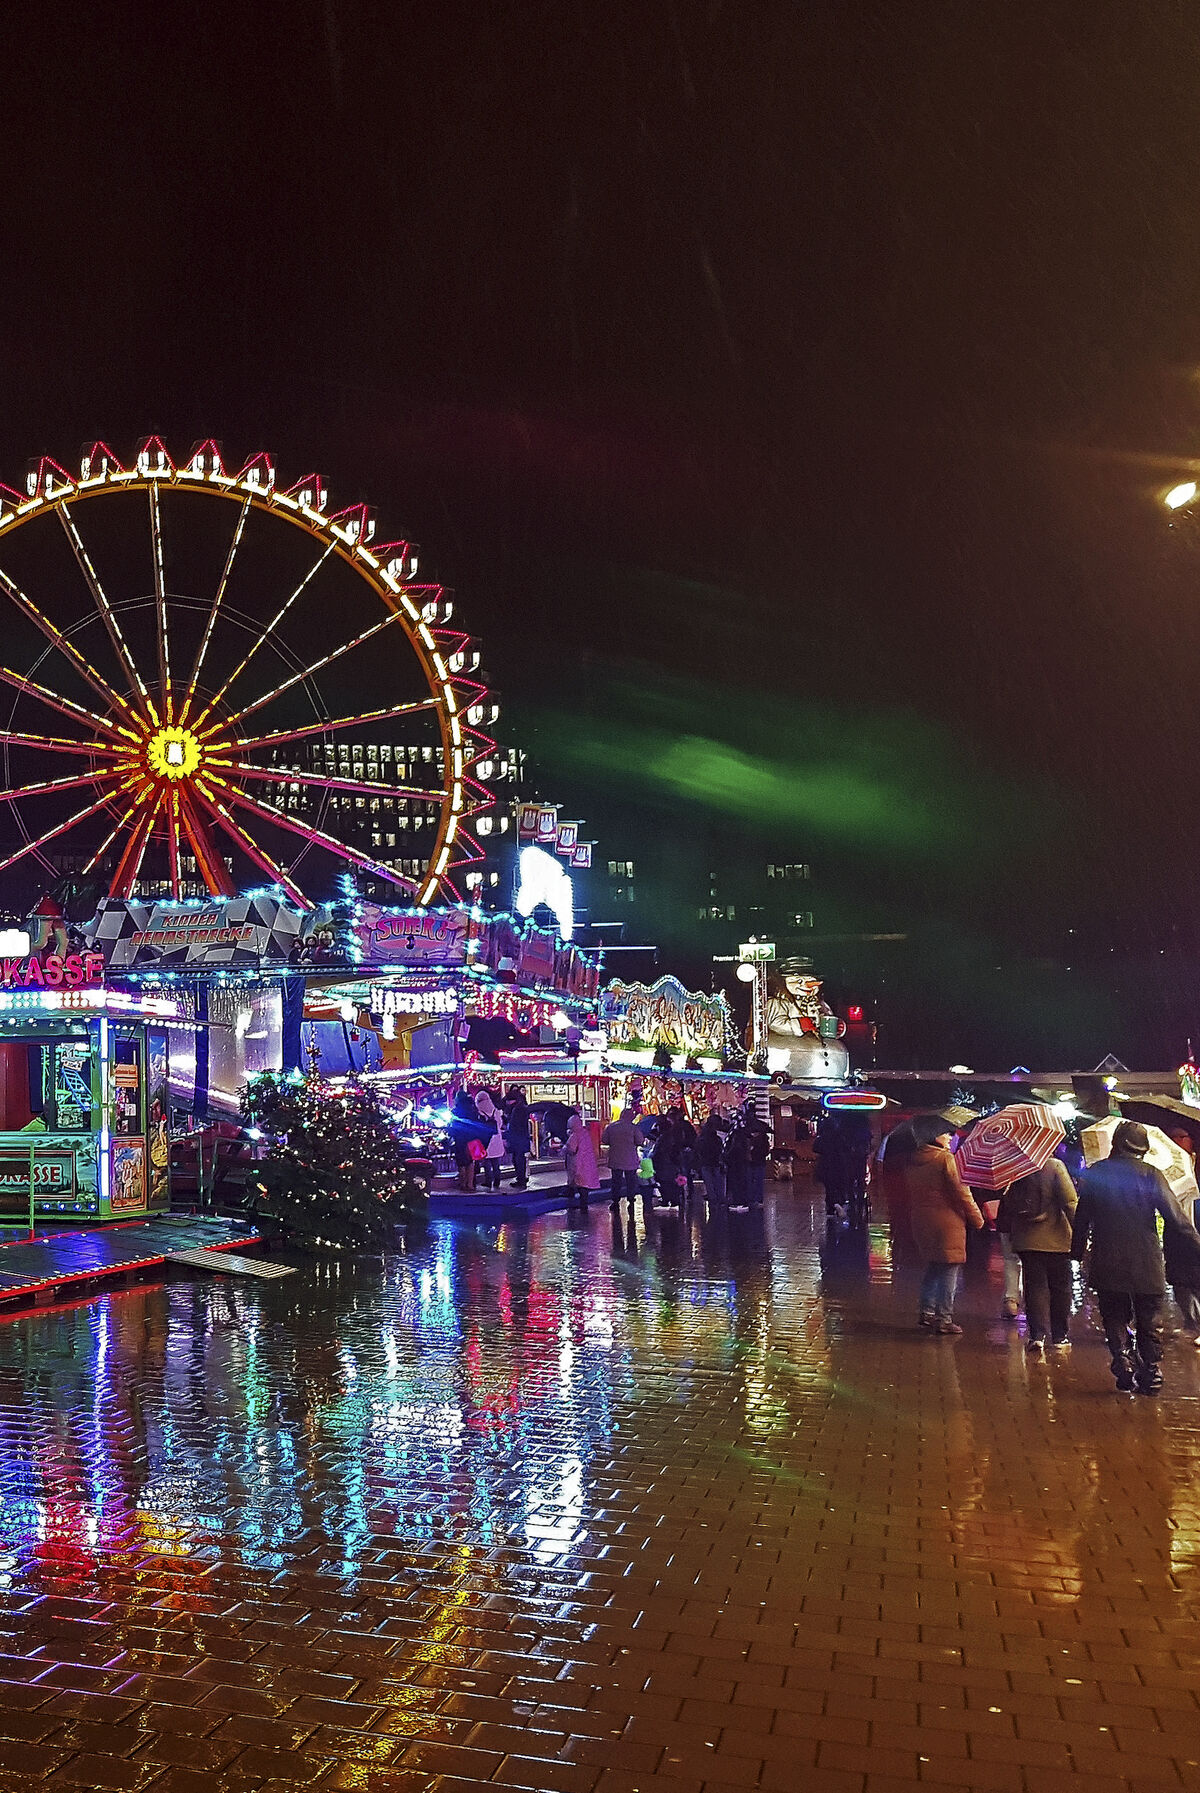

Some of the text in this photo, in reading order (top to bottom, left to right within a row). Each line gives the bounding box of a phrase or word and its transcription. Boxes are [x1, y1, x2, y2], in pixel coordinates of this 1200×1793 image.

[163, 913, 218, 928] KINDER
[130, 927, 254, 946] RENNSTRECKE
[371, 987, 459, 1013] HAMBURG
